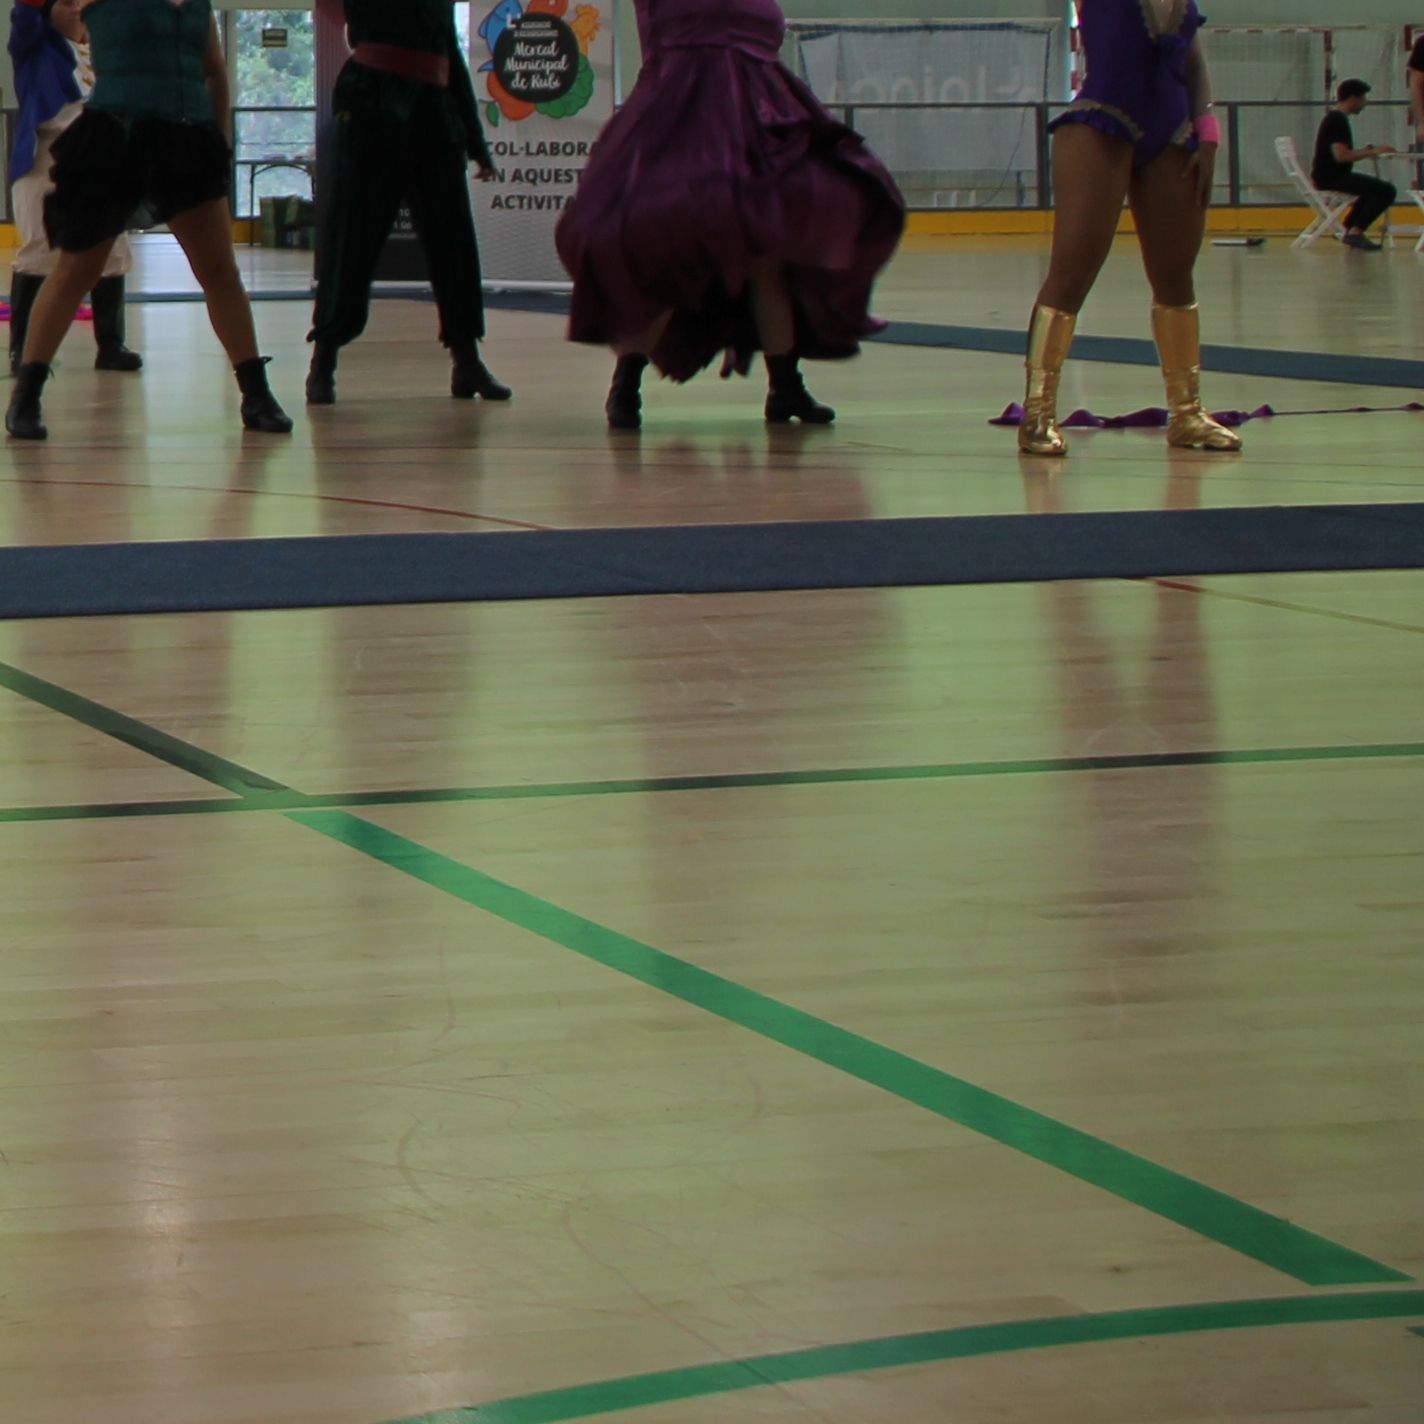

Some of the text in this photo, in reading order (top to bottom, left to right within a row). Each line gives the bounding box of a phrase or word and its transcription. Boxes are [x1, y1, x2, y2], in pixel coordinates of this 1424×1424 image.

[514, 41, 559, 56] Mercat
[504, 55, 568, 76] Municipal
[511, 72, 528, 89] de
[511, 168, 584, 186] AQUEST
[491, 195, 575, 211] ACTIVITA
